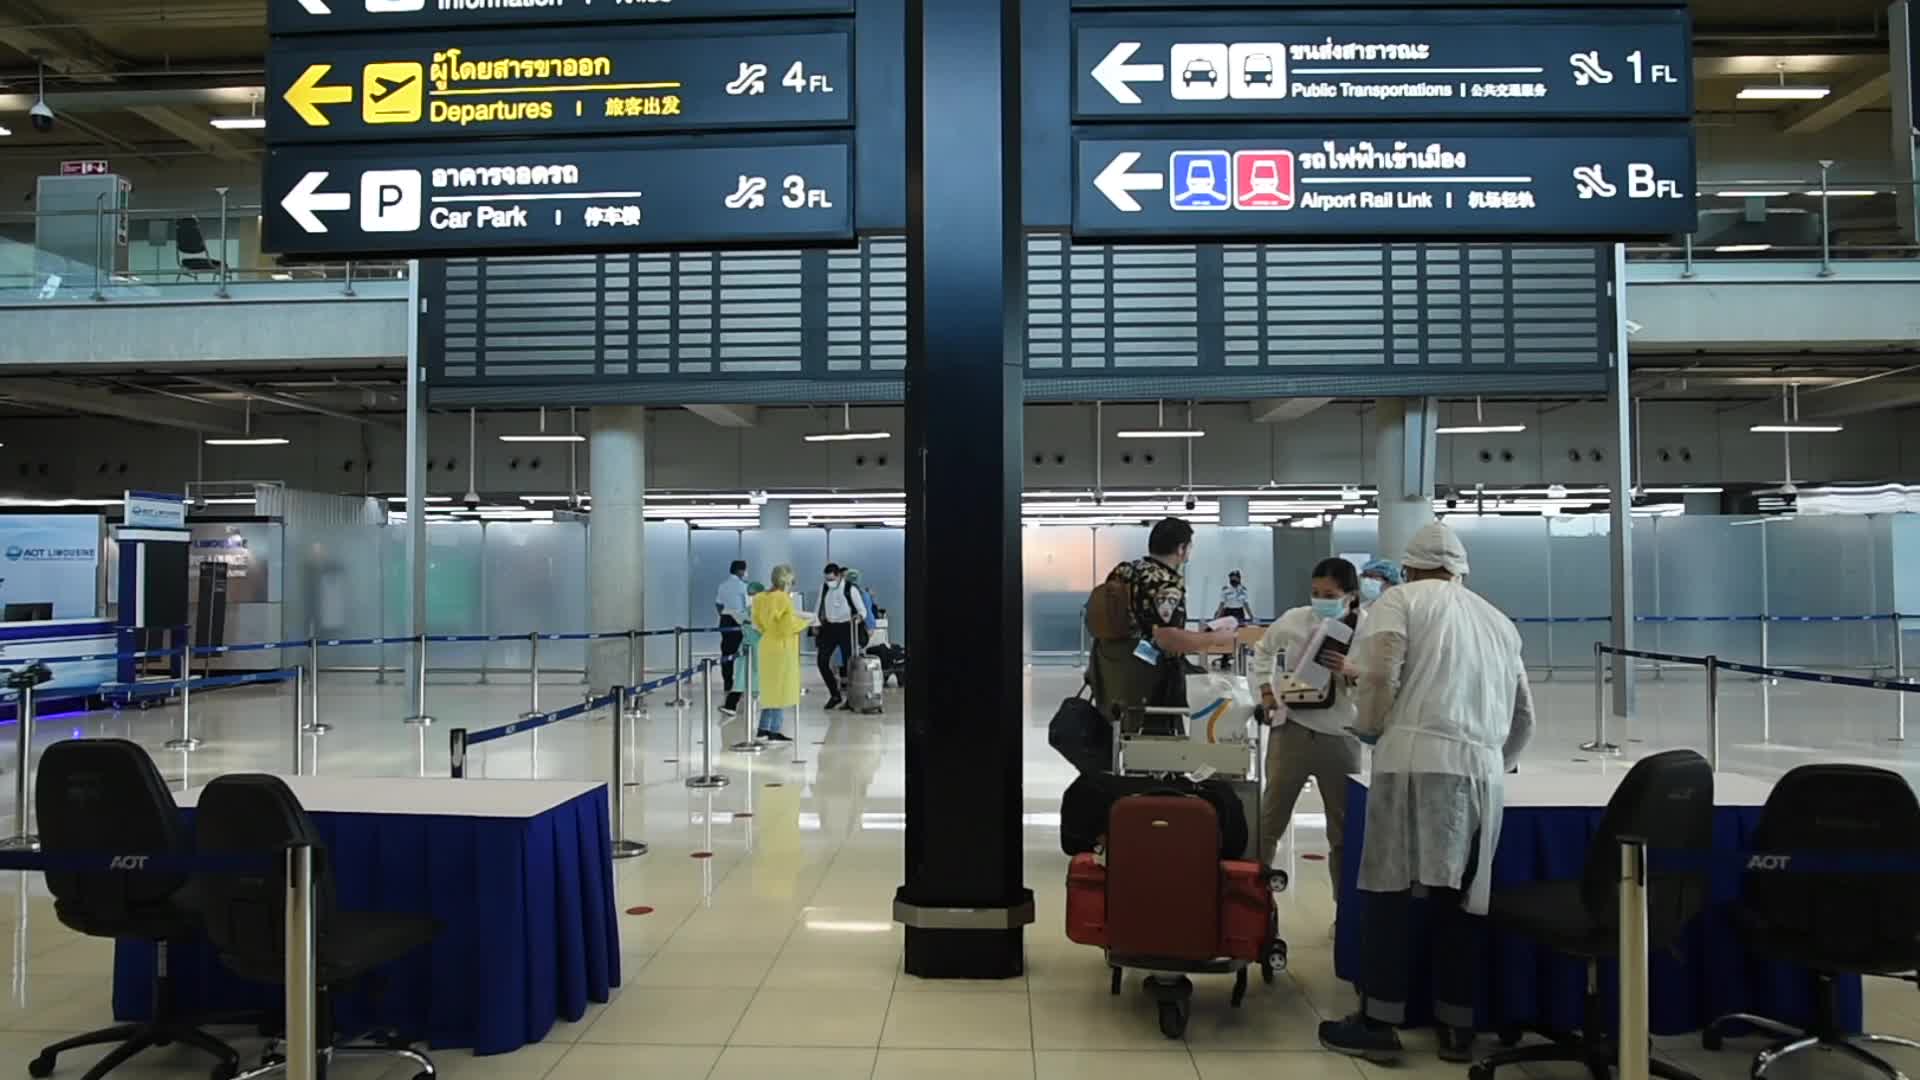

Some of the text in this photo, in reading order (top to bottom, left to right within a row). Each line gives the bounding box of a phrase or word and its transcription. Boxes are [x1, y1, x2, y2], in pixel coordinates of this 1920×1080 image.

[1290, 36, 1430, 60] ขนส่งสาธารณะ
[430, 49, 610, 90] ผู้โดยสารขาออก
[1291, 82, 1453, 100] Public Transportations
[430, 101, 552, 126] Departures
[605, 96, 680, 117] 旅客出发
[1298, 140, 1467, 169] รถไฟฟ้าเข้าเมือง
[432, 165, 578, 187] อาคารจอดรถ
[1300, 191, 1433, 211] Airport Rail Link
[430, 205, 528, 229] Car Park
[23, 549, 44, 557] AOT
[110, 855, 149, 870] AOT
[1747, 855, 1792, 870] AOT
